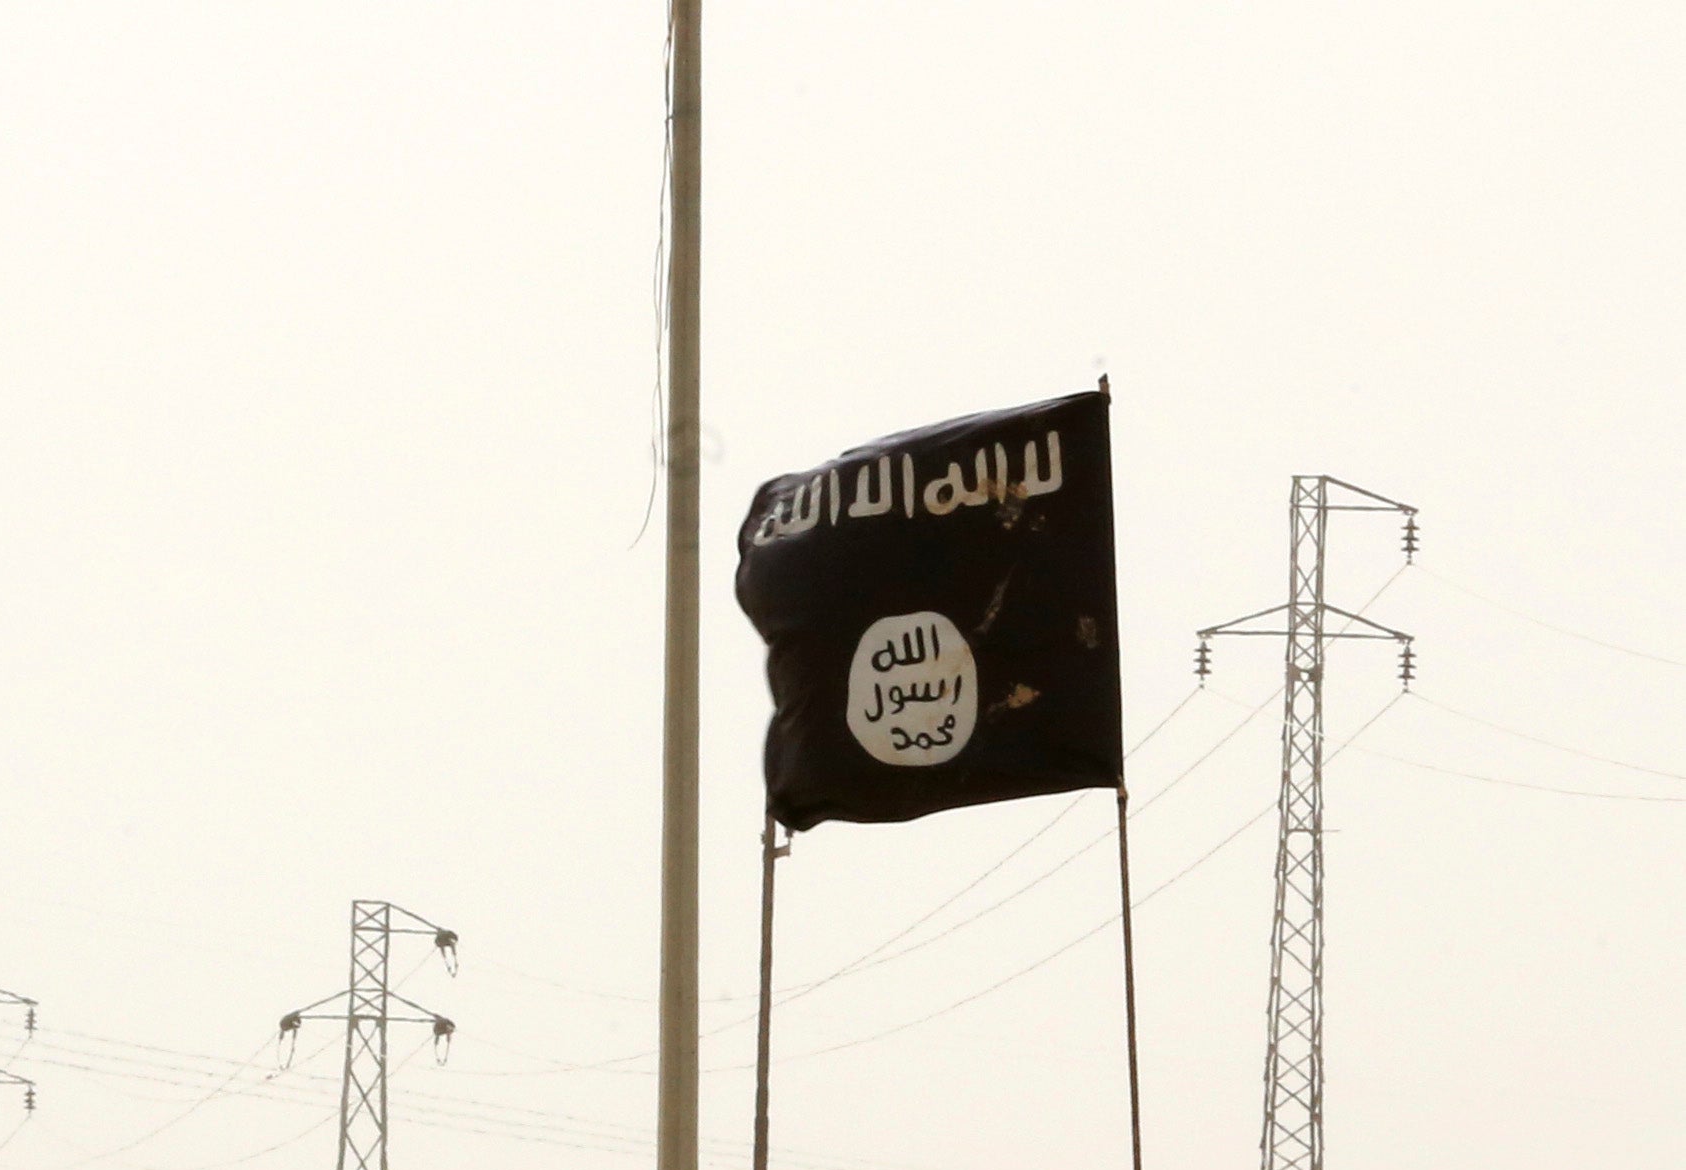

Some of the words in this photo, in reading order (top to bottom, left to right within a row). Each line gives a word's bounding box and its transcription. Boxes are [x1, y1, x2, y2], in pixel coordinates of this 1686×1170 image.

[1024, 430, 1063, 497] لا
[753, 468, 841, 547] الله
[871, 623, 940, 672] الله
[865, 674, 962, 722] رسول
[890, 714, 956, 750] محمد
